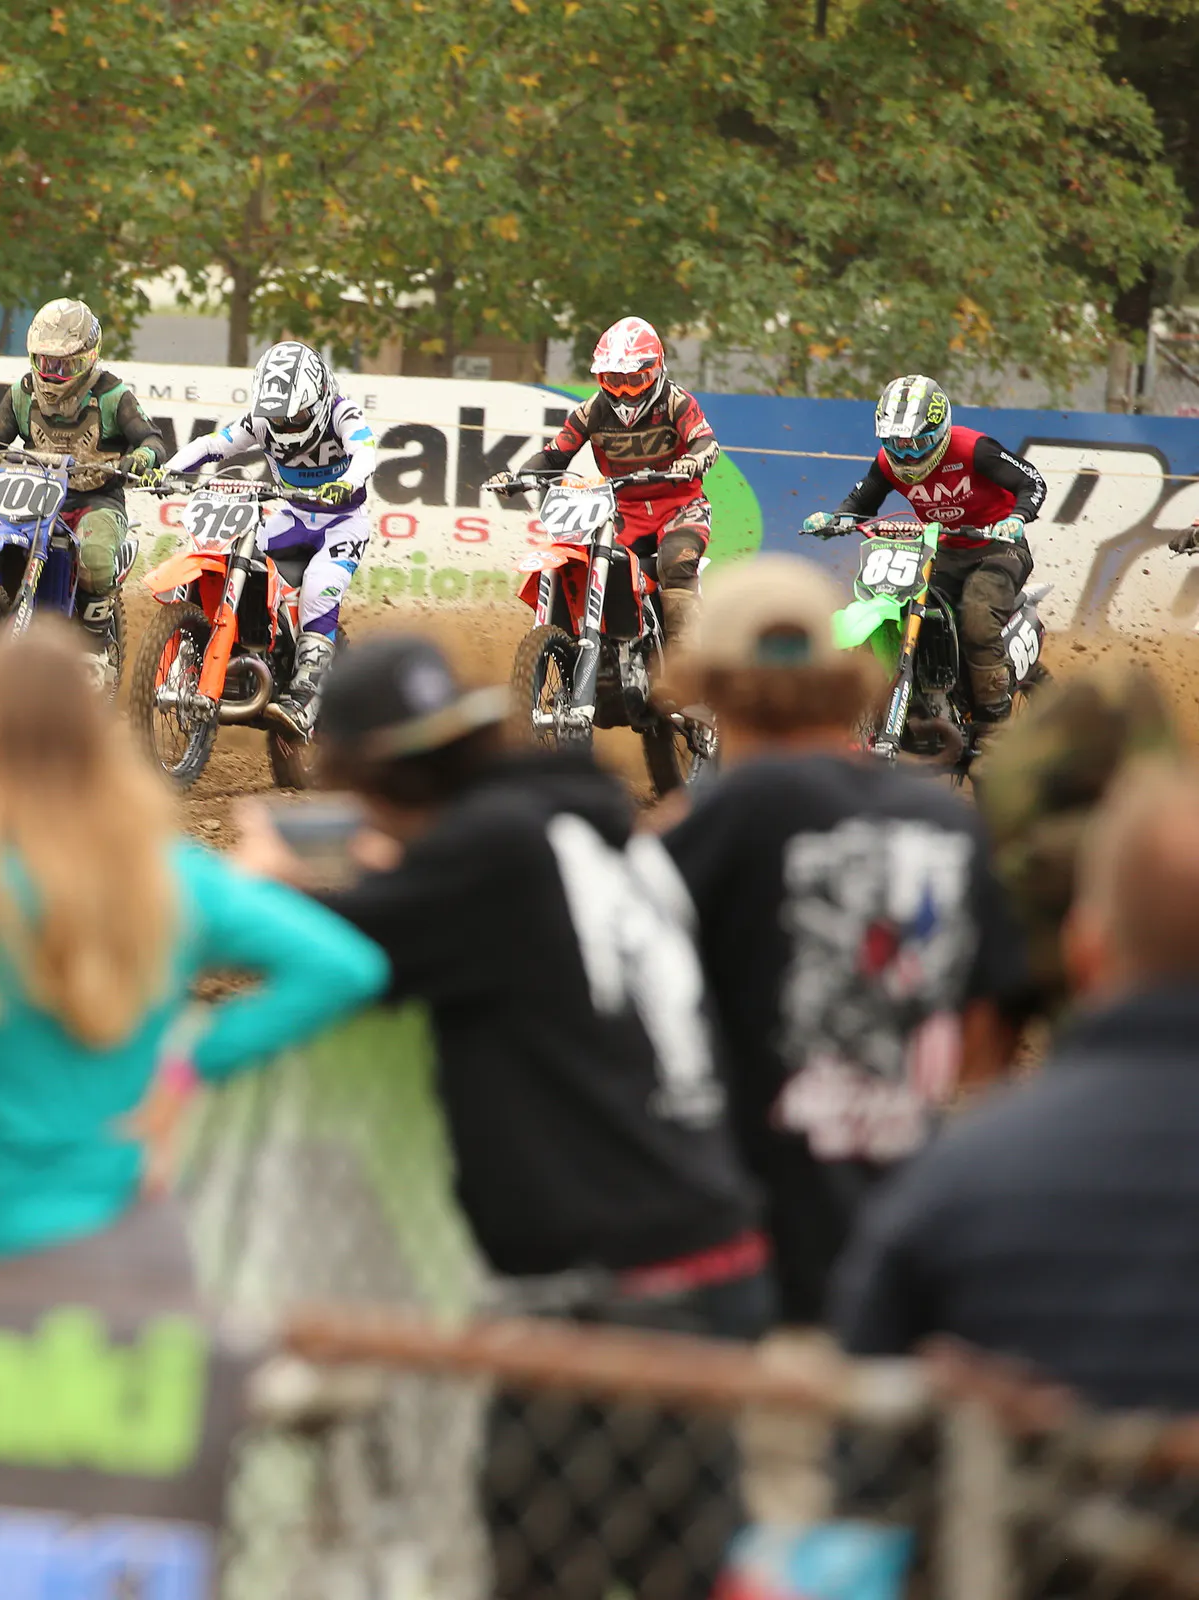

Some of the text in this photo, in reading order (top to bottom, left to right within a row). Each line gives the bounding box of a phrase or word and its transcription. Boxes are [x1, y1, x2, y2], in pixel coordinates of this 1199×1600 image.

[907, 475, 971, 502] AM
[191, 503, 254, 539] 319
[545, 498, 611, 533] 270
[931, 508, 958, 518] Arai
[862, 549, 920, 587] 85
[1009, 620, 1039, 681] 85
[894, 680, 910, 737] DUNLOP
